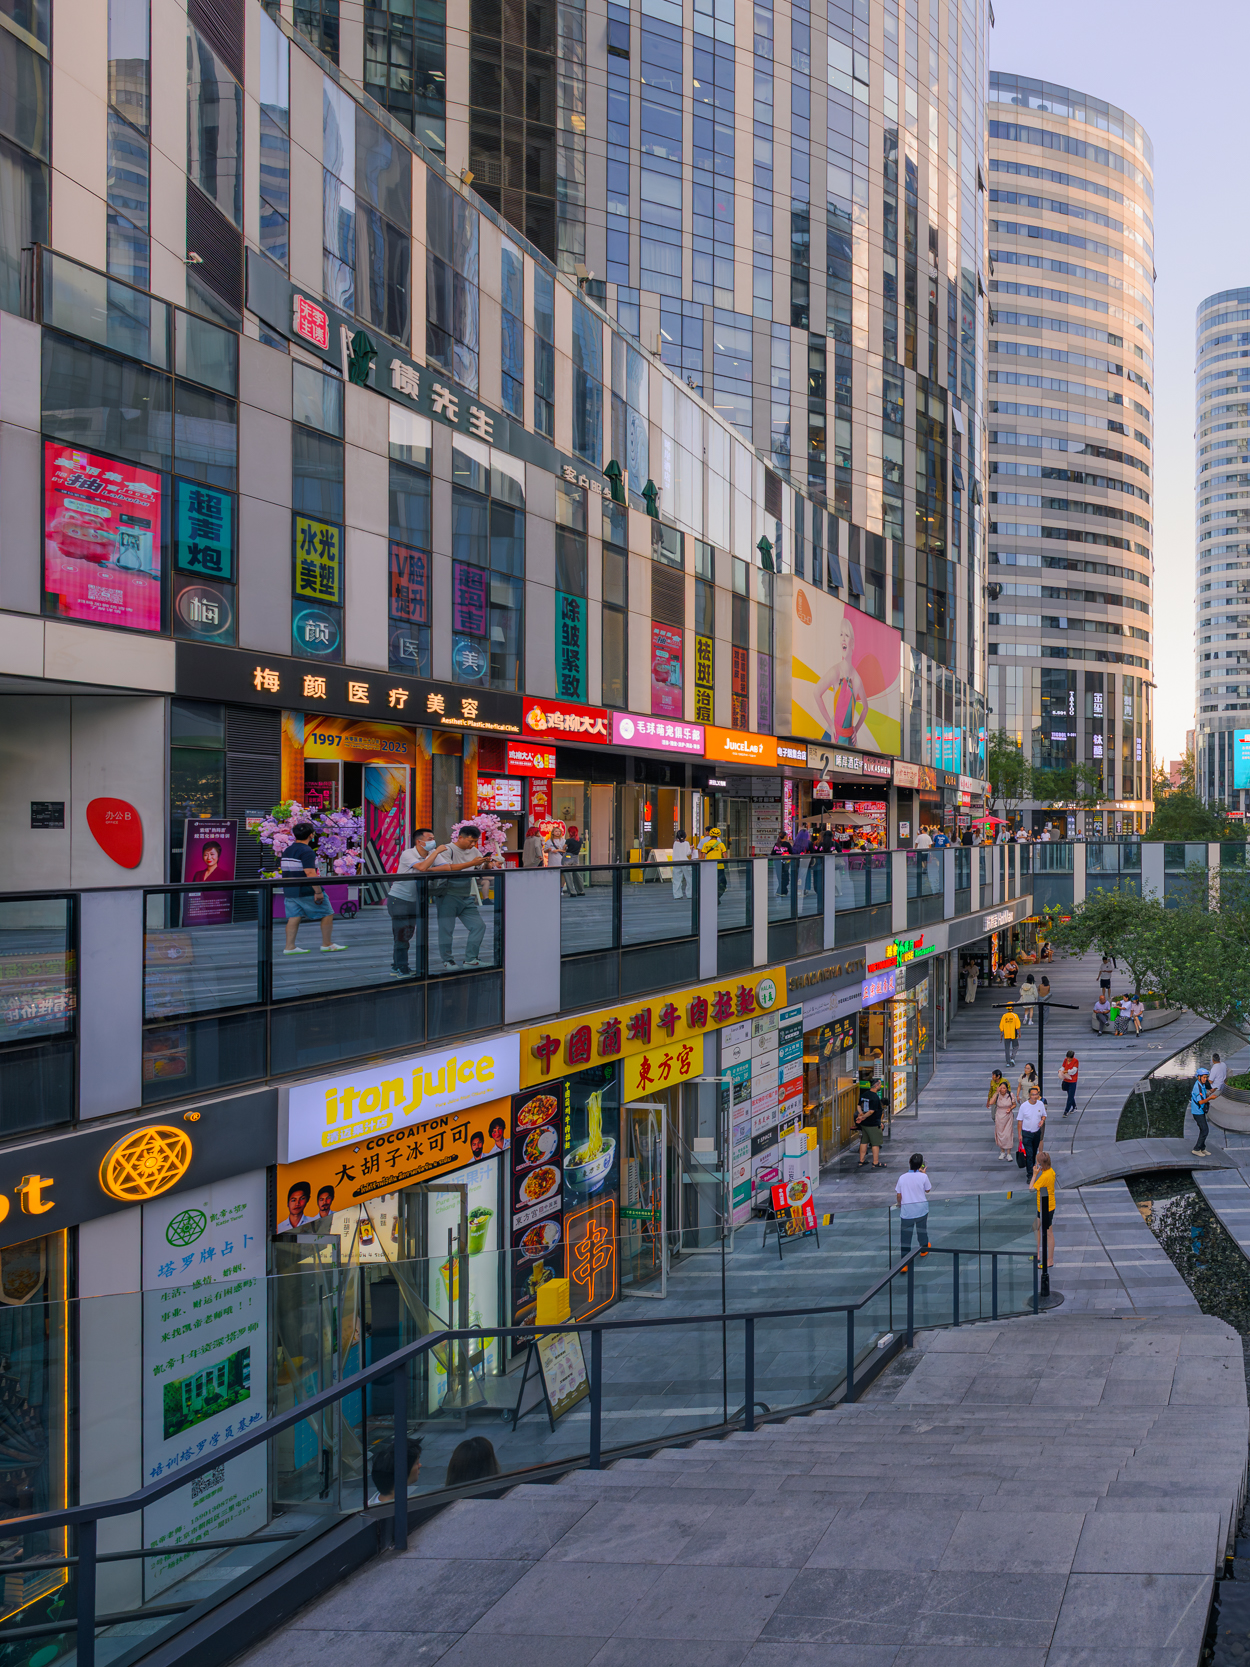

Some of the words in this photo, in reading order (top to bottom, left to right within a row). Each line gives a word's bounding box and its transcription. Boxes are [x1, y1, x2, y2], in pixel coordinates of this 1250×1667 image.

[187, 489, 223, 573] 超声炮
[300, 524, 336, 558] 水光
[300, 558, 336, 597] 美塑
[394, 553, 426, 586] V脸
[189, 596, 219, 625] 梅
[395, 585, 426, 618] 提升
[457, 565, 486, 633] 超玛吉
[304, 619, 330, 645] 颜
[400, 638, 420, 659] 医
[560, 596, 581, 700] 除皱紧致
[461, 650, 480, 672] 美
[254, 666, 479, 719] 梅颜医疗美容
[311, 732, 342, 747] 1997
[547, 711, 608, 735] 鸡柳大人
[636, 720, 701, 741] 毛球萌宠俱乐部
[381, 740, 407, 753] 2025
[105, 811, 123, 820] 办公
[125, 812, 131, 820] B
[326, 1117, 388, 1143] 清迈果汁店
[366, 1116, 448, 1150] COCOAITON
[335, 1120, 471, 1188] 大胡子冰可可
[157, 1234, 253, 1278] 塔罗牌占卜
[149, 1412, 263, 1478] 培训塔罗学员基地
